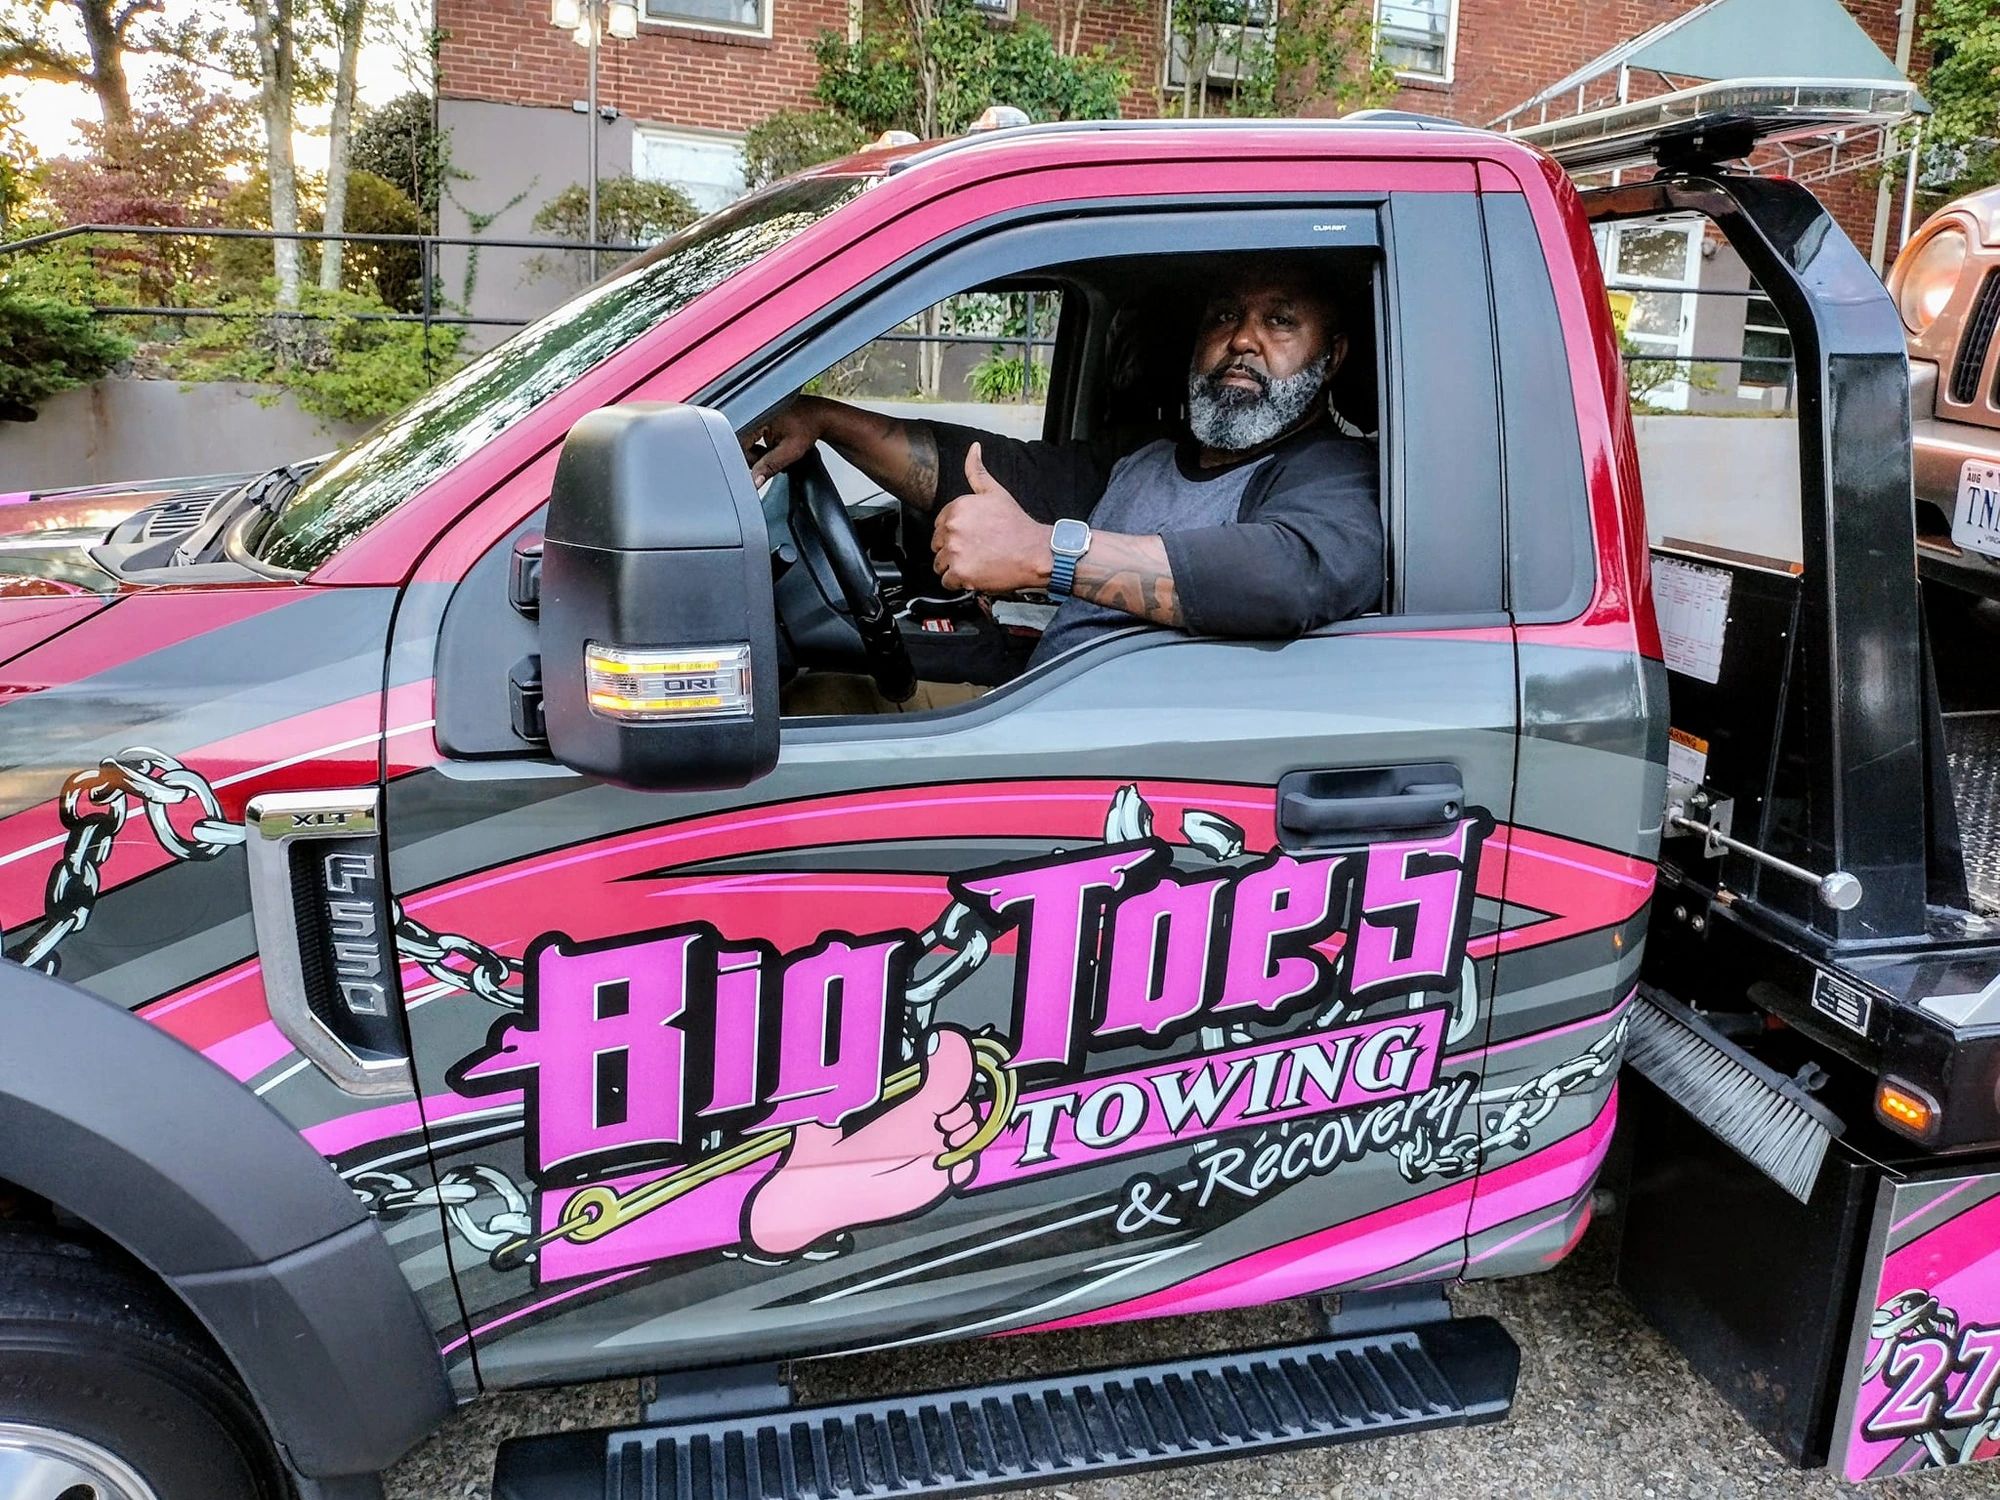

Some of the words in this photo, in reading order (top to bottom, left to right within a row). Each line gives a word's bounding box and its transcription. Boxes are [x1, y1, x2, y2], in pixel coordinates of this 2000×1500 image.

[1966, 472, 1981, 484] AUG
[1967, 486, 2000, 533] TN
[1669, 728, 1697, 750] ARNING
[291, 813, 353, 829] XLT
[324, 852, 388, 1017] F550
[460, 930, 907, 1175] Big
[960, 816, 1481, 1070] Toes
[1010, 1024, 1423, 1166] TOWING
[1114, 1180, 1182, 1235] &
[1193, 1077, 1472, 1208] Recovery
[1866, 1328, 2000, 1431] 27
